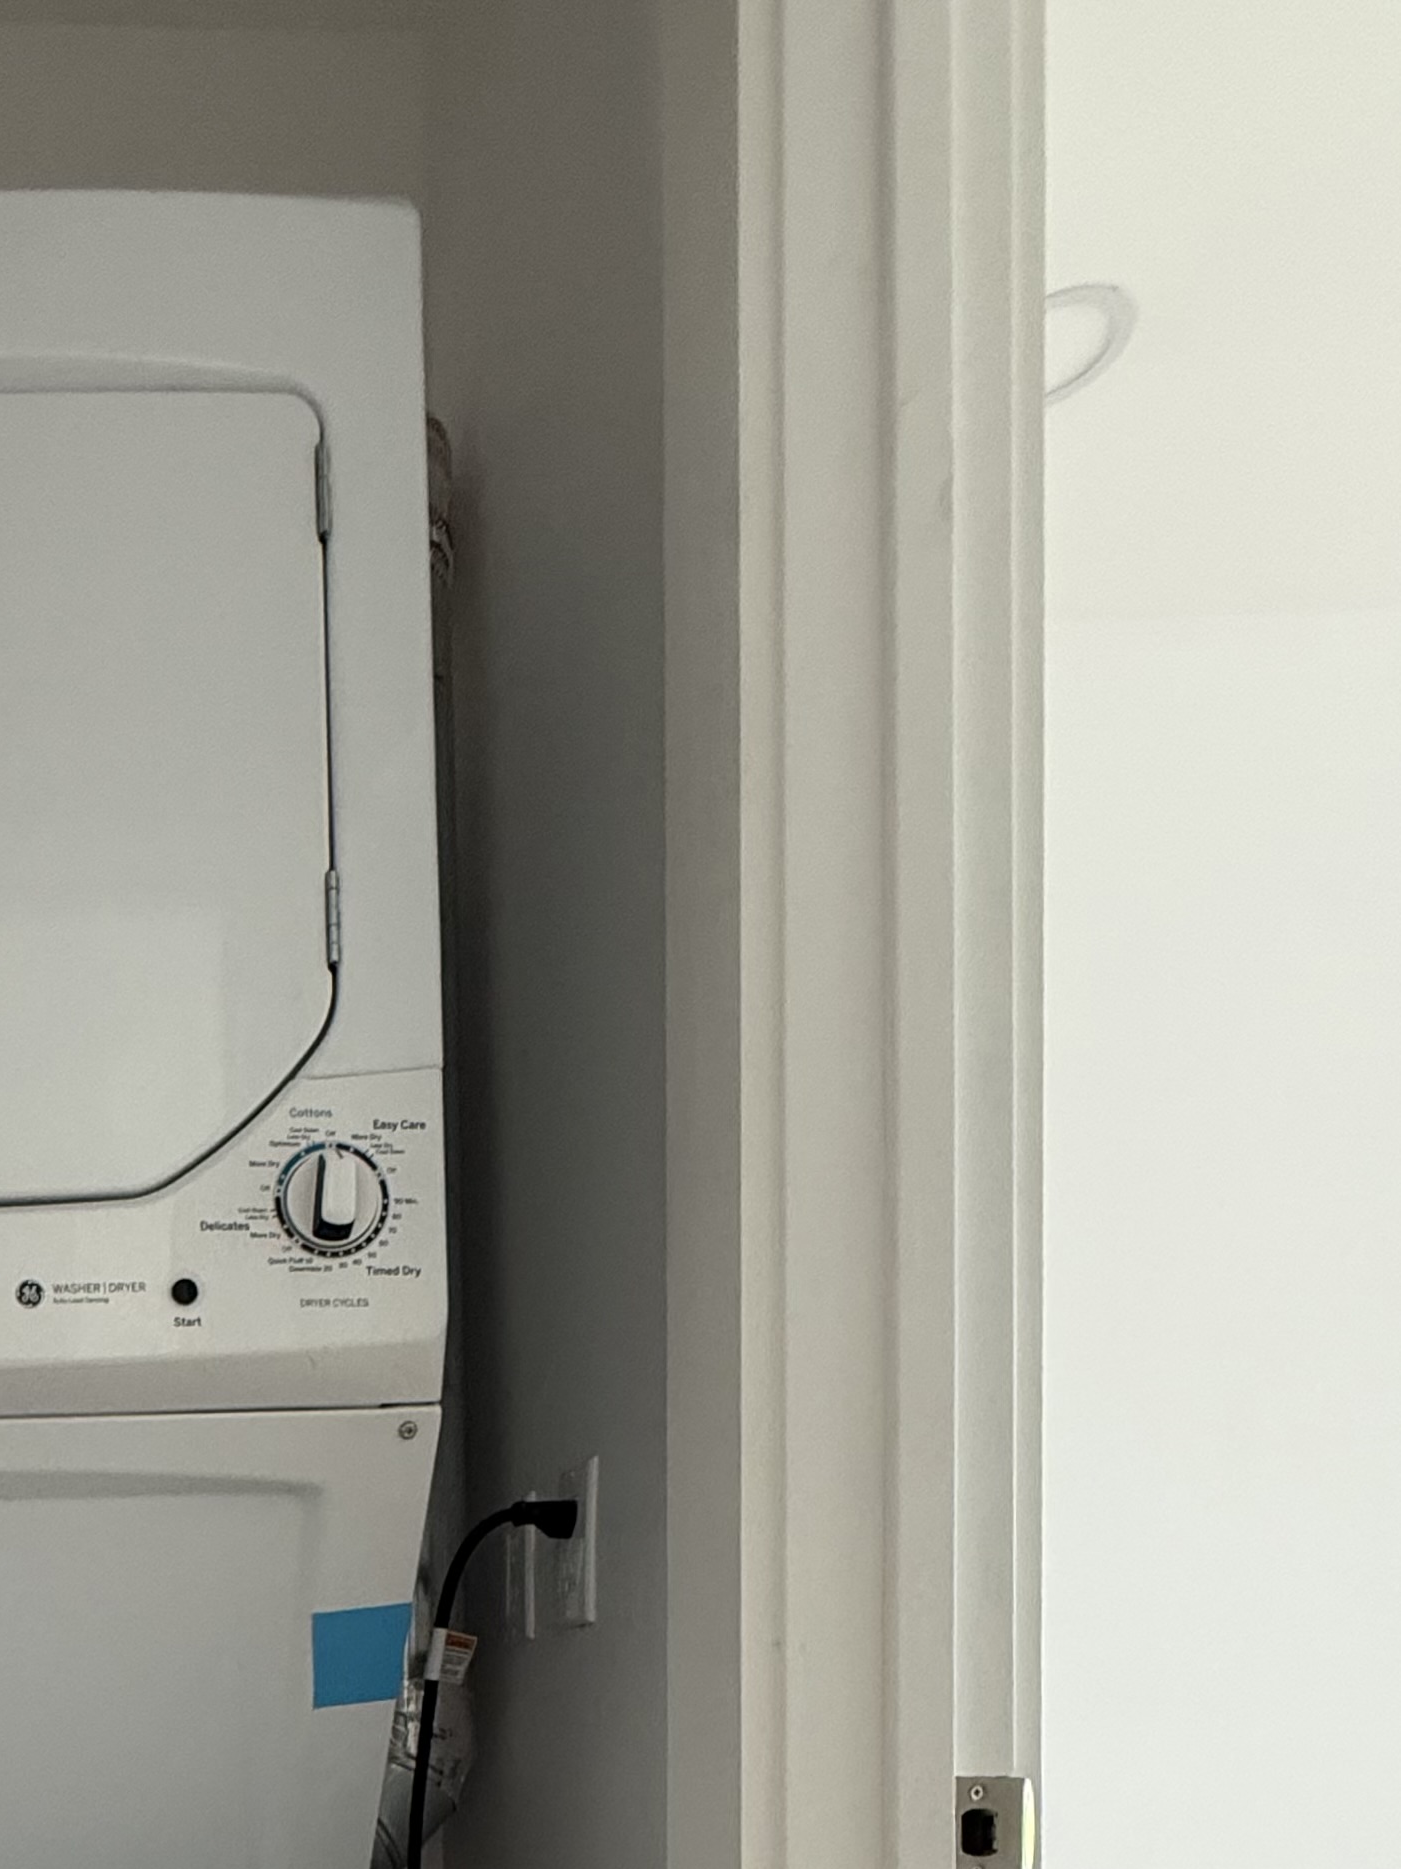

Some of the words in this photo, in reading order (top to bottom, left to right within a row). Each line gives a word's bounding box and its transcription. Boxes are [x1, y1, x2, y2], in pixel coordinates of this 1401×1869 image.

[289, 1107, 332, 1118] Cottons
[373, 1119, 399, 1132] Easy
[400, 1119, 426, 1130] Care
[200, 1220, 250, 1231] Delicates
[366, 1265, 400, 1276] Timed
[401, 1264, 422, 1278] Dry
[52, 1283, 100, 1294] WASHER
[108, 1281, 146, 1293] DRYER
[300, 1298, 331, 1308] DRYER
[332, 1297, 369, 1308] CYCLES
[173, 1316, 202, 1327] Start
